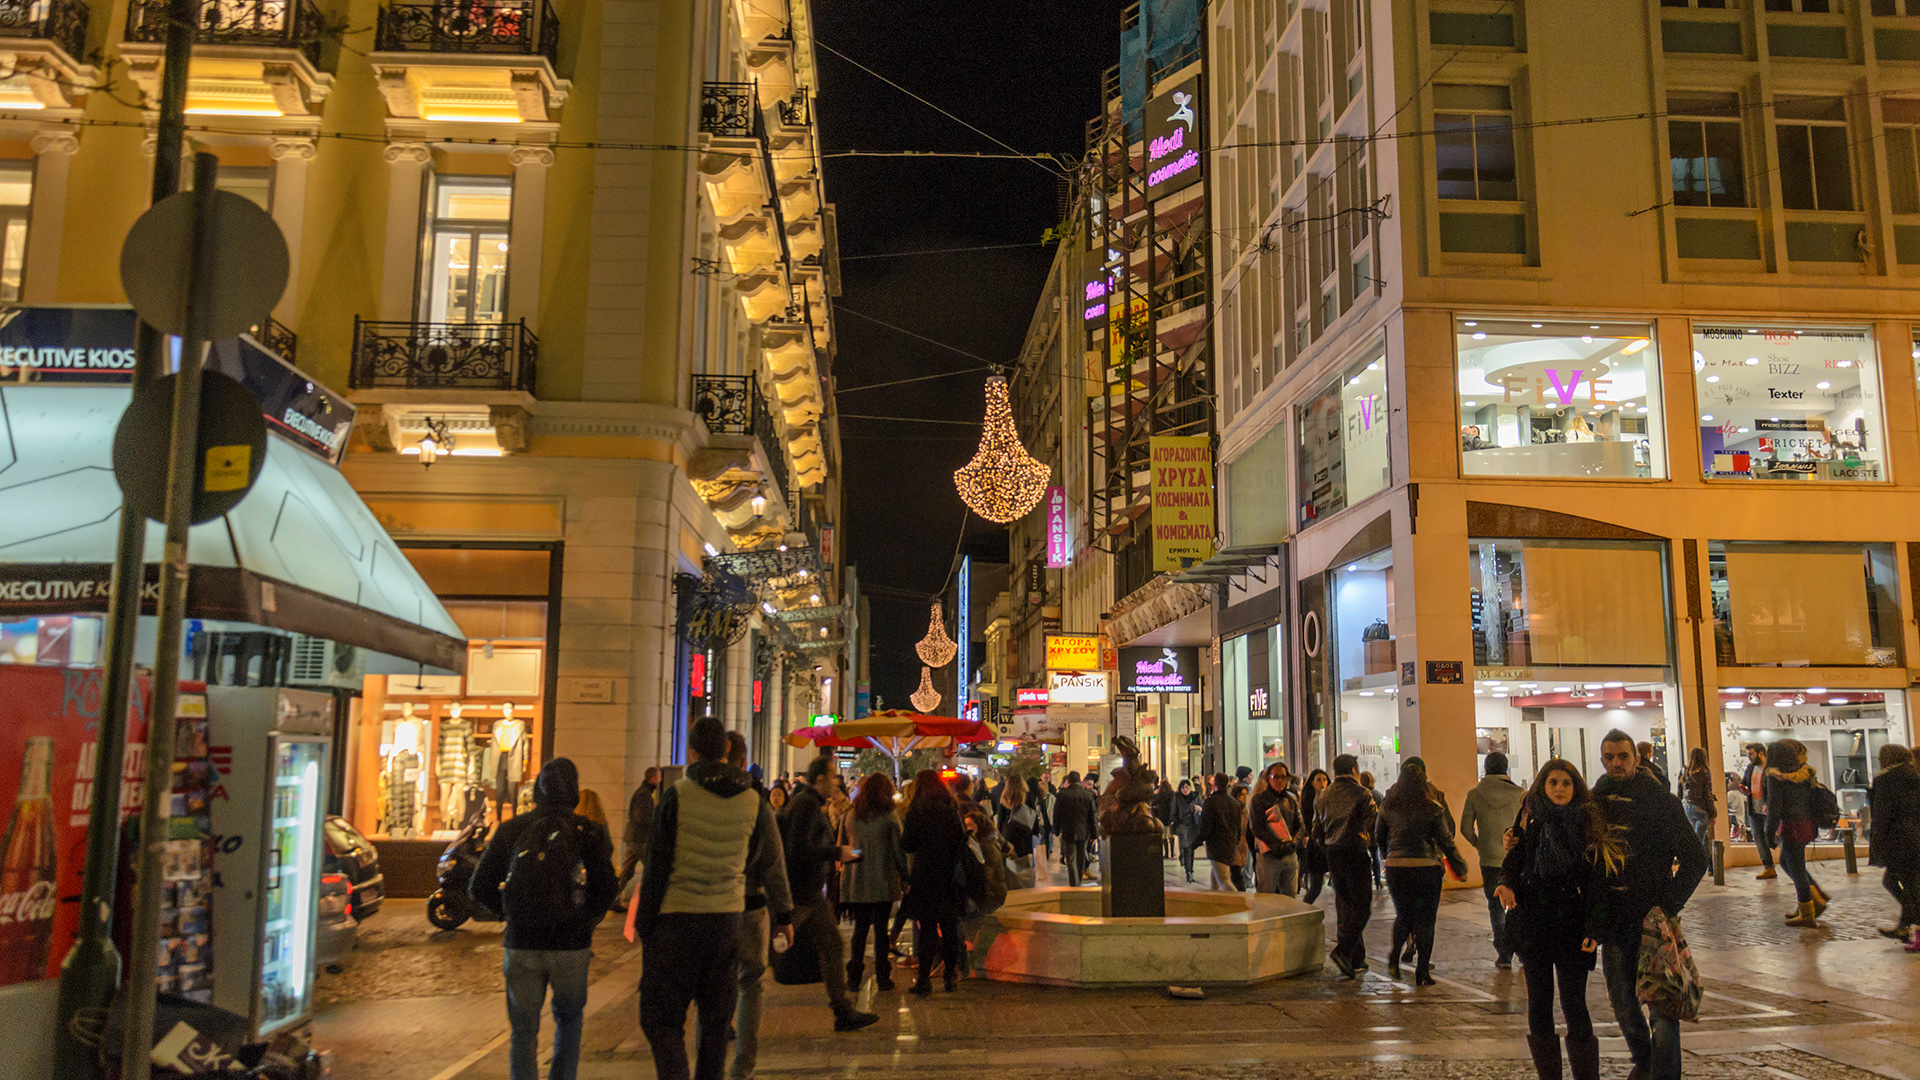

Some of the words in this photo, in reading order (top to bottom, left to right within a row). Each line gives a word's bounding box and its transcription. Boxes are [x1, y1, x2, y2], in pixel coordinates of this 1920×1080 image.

[1149, 127, 1183, 162] Medi
[1148, 149, 1199, 187] cosmetic
[1703, 328, 1743, 340] MOSCHINO
[1763, 330, 1799, 341] BOSS
[1767, 353, 1789, 362] Shoe
[1769, 363, 1801, 375] BIZZ
[1767, 388, 1804, 399] Texter
[1834, 428, 1869, 436] GEOX
[1764, 437, 1824, 448] KRICKET
[1153, 447, 1210, 463] ΑΓΟΡΑΖΟΝΤΑΙ
[1157, 467, 1207, 487] ΧΡΥΣΑ
[1833, 469, 1878, 478] LACOSTE
[1155, 492, 1210, 507] ΚΟΣΜΗΜΑΤΑ
[1178, 510, 1188, 520] &
[1156, 524, 1212, 540] ΝΟΜΙΣΜΑΤΑ
[686, 609, 732, 639] H&M
[1054, 638, 1092, 647] ΑΓΟΡΑ
[1049, 646, 1096, 655] ΧΡΥΣΟΥ
[1135, 660, 1163, 674] Medi
[1135, 672, 1183, 686] cosmetic
[1018, 691, 1036, 702] pink
